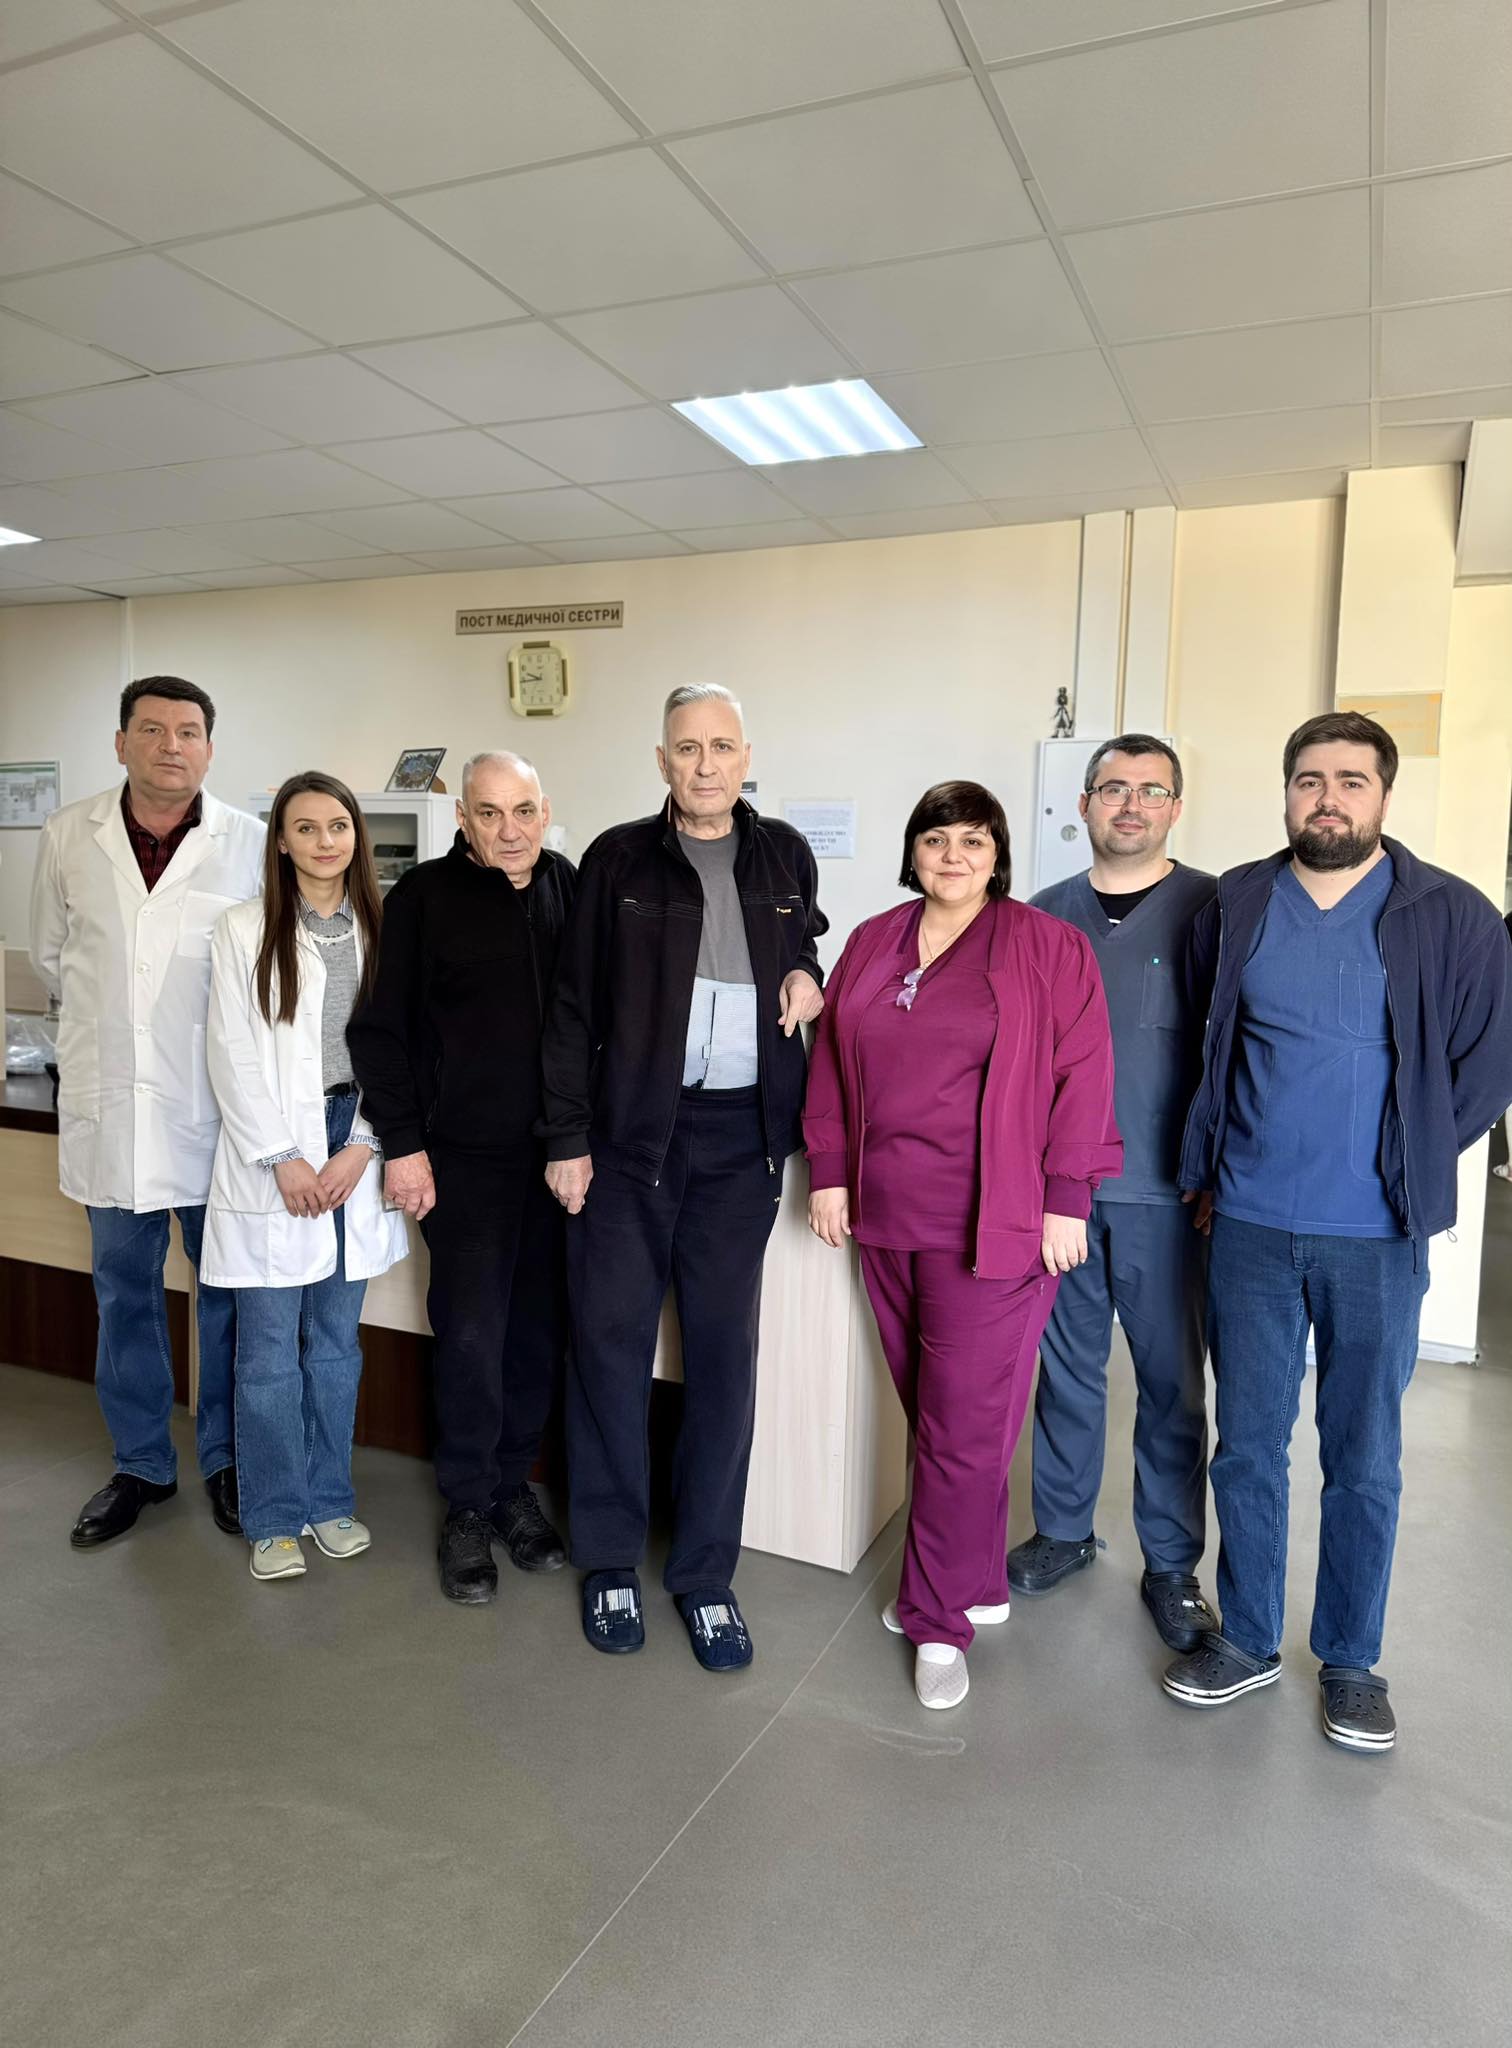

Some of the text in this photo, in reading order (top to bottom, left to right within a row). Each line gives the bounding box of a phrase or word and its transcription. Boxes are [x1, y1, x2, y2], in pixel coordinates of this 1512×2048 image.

[460, 608, 620, 628] ПОСТ МЕДИЧНОЇ СЕСТРИ
